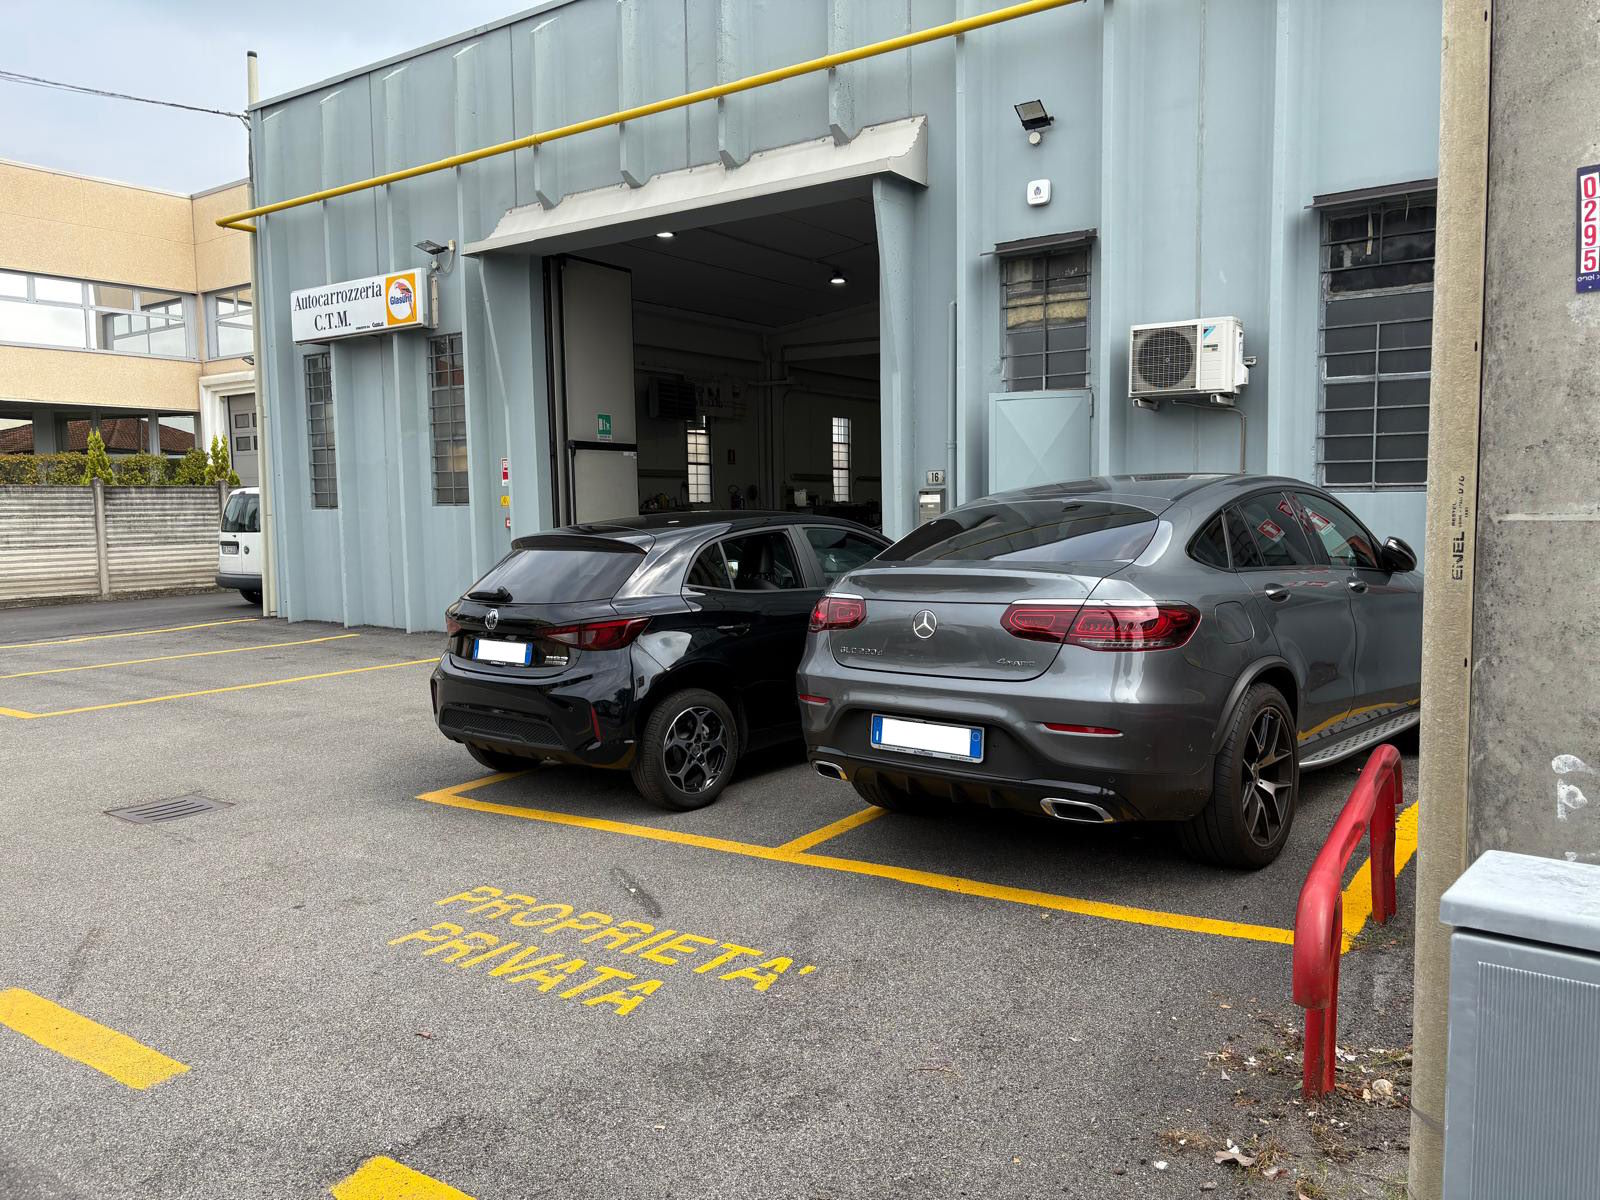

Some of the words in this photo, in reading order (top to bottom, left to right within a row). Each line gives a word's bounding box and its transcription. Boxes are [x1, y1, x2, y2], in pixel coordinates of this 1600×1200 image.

[1583, 176, 1597, 271] 0295
[293, 281, 383, 311] Autocarrozzeria
[389, 293, 413, 305] Glasurit
[314, 310, 352, 332] C.T.M.
[931, 472, 939, 482] 16
[1452, 531, 1465, 580] ENEL
[435, 885, 817, 992] PROPRIETA'
[388, 922, 665, 1016] PRIVATA
